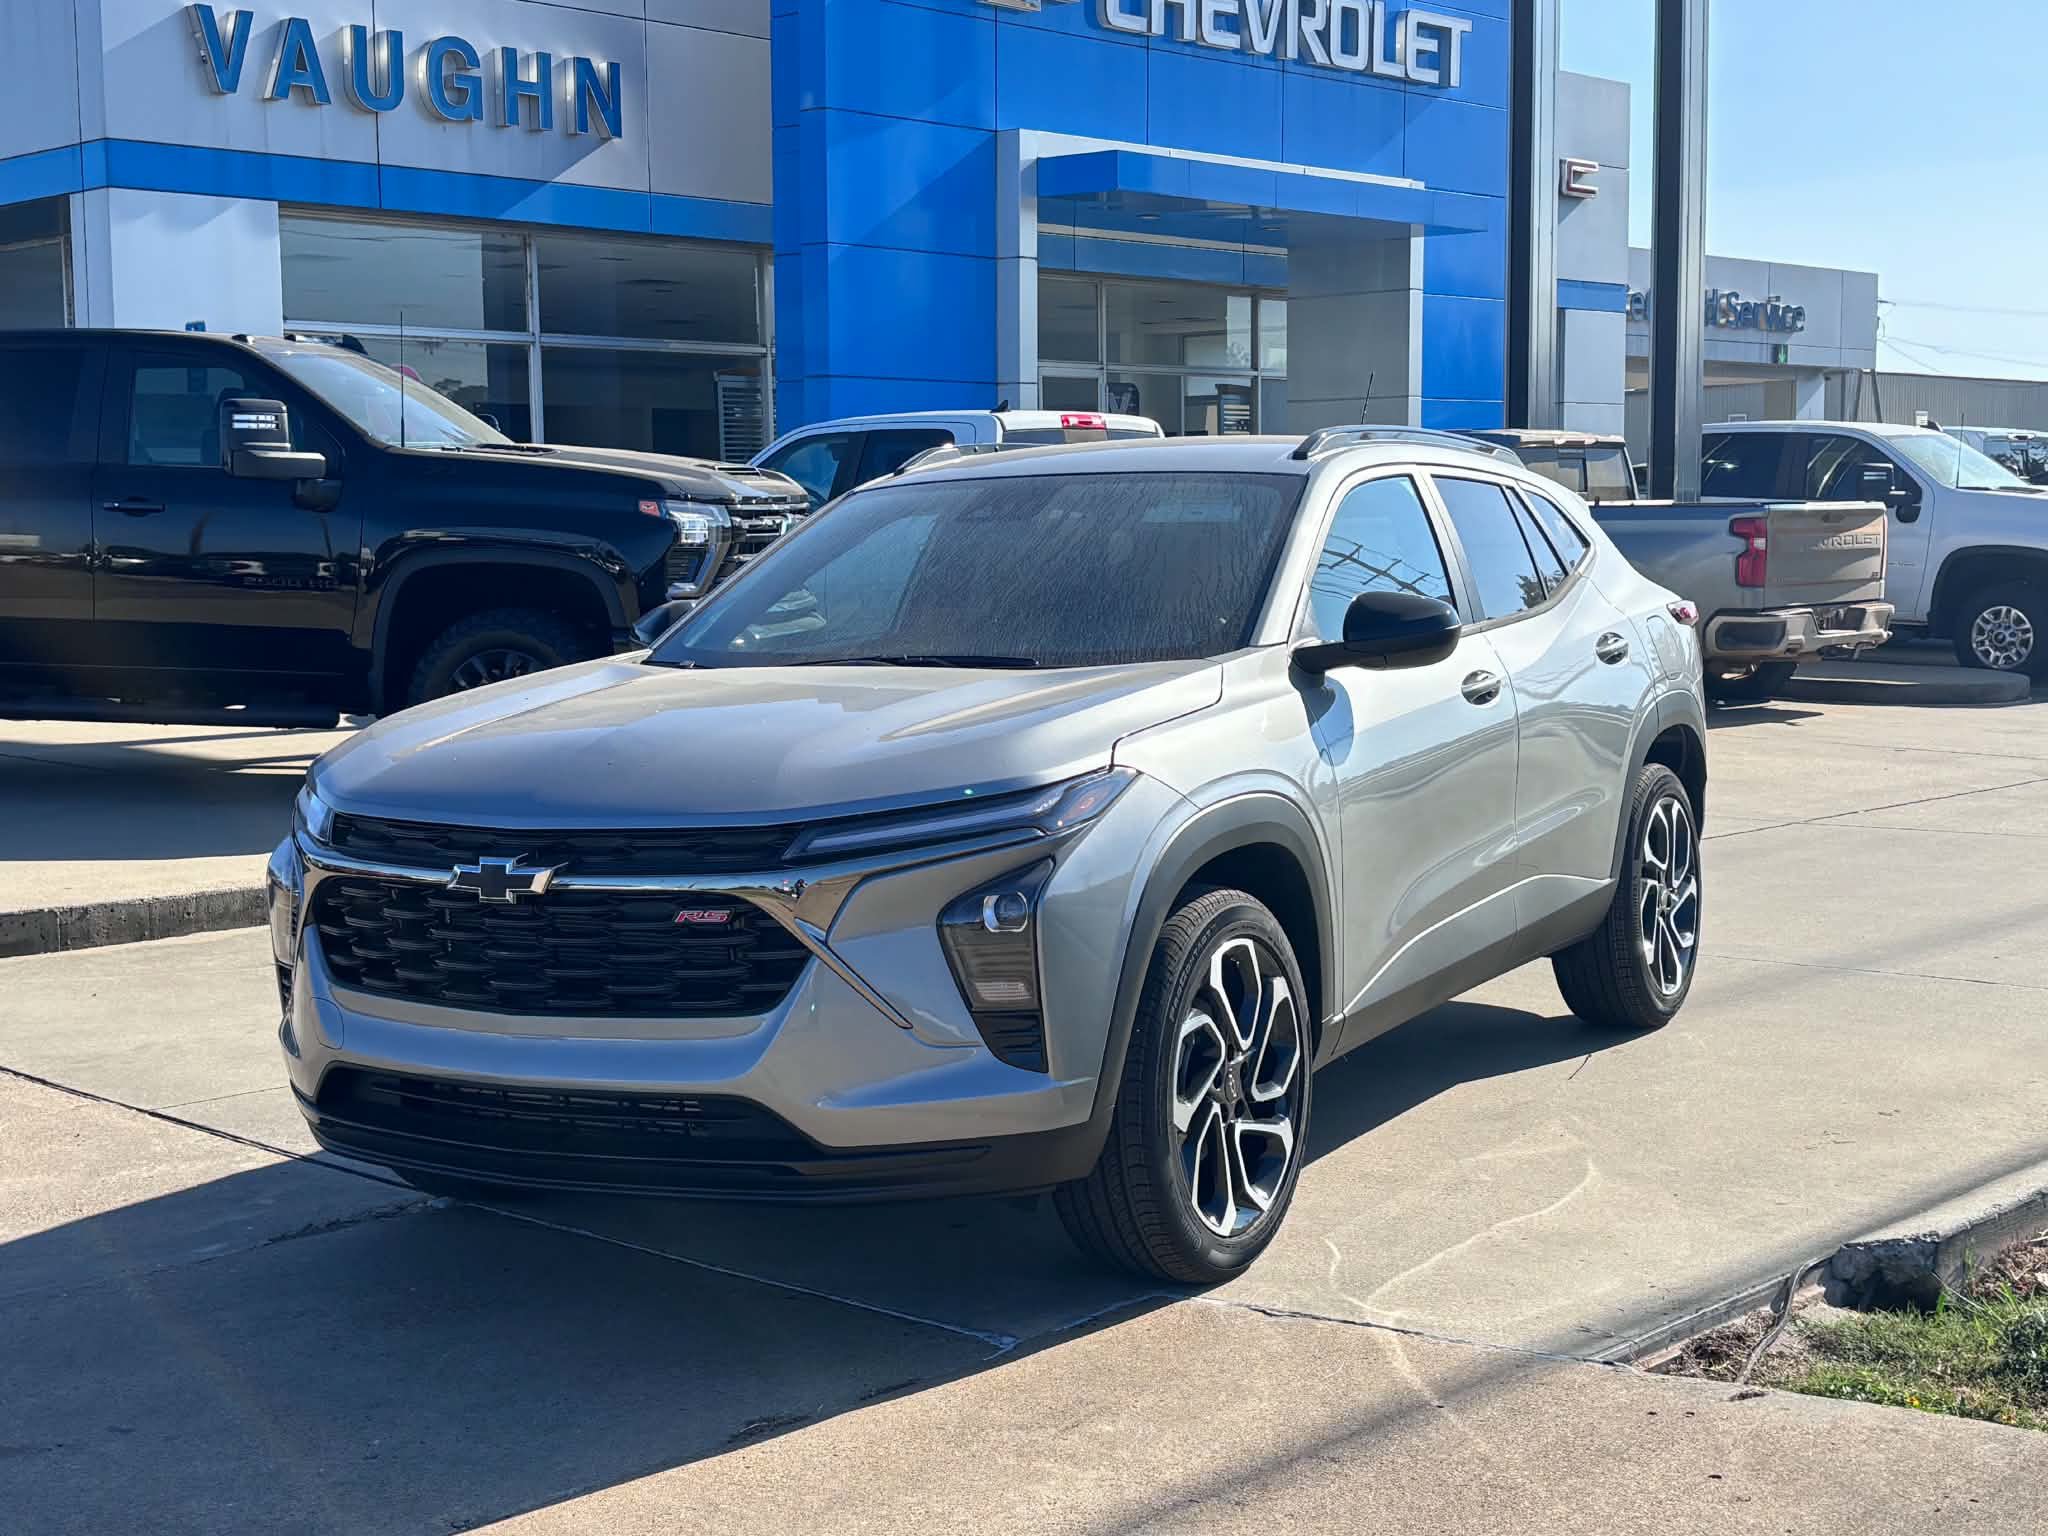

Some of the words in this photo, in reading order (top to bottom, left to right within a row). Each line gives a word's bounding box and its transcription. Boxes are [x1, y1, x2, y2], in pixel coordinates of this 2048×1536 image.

[188, 4, 623, 139] VAUGHN
[1722, 291, 1806, 332] Service
[674, 910, 731, 923] RS
